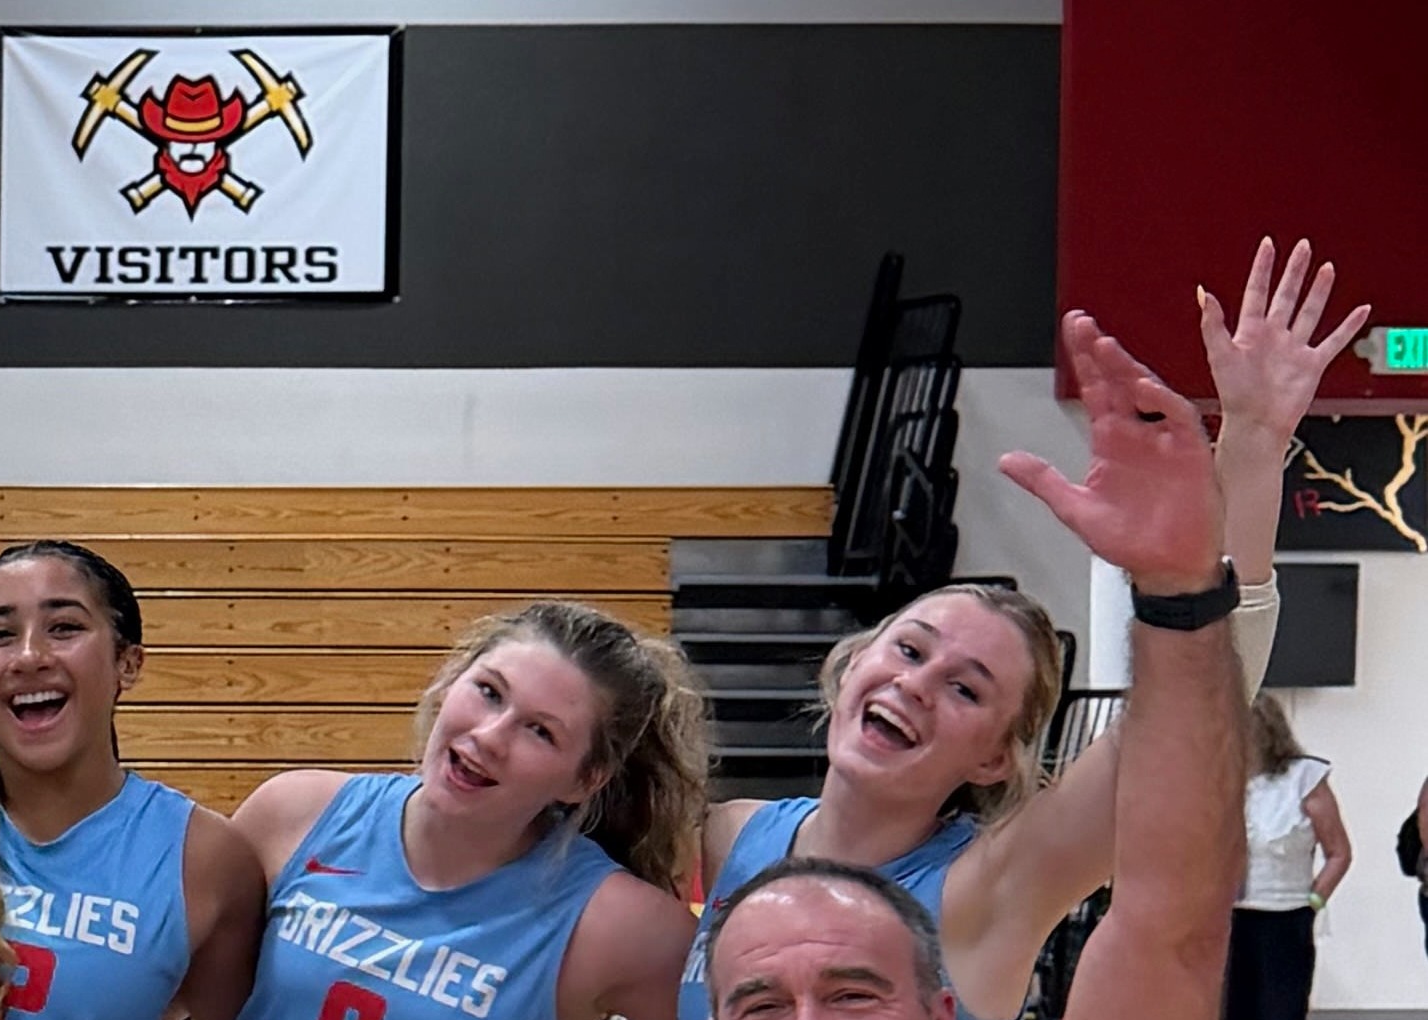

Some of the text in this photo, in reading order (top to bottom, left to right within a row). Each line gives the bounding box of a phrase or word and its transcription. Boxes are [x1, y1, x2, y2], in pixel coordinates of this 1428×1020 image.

[46, 246, 339, 285] VISITORS
[1387, 328, 1428, 369] EXI
[277, 891, 508, 1019] GRIZZLIES
